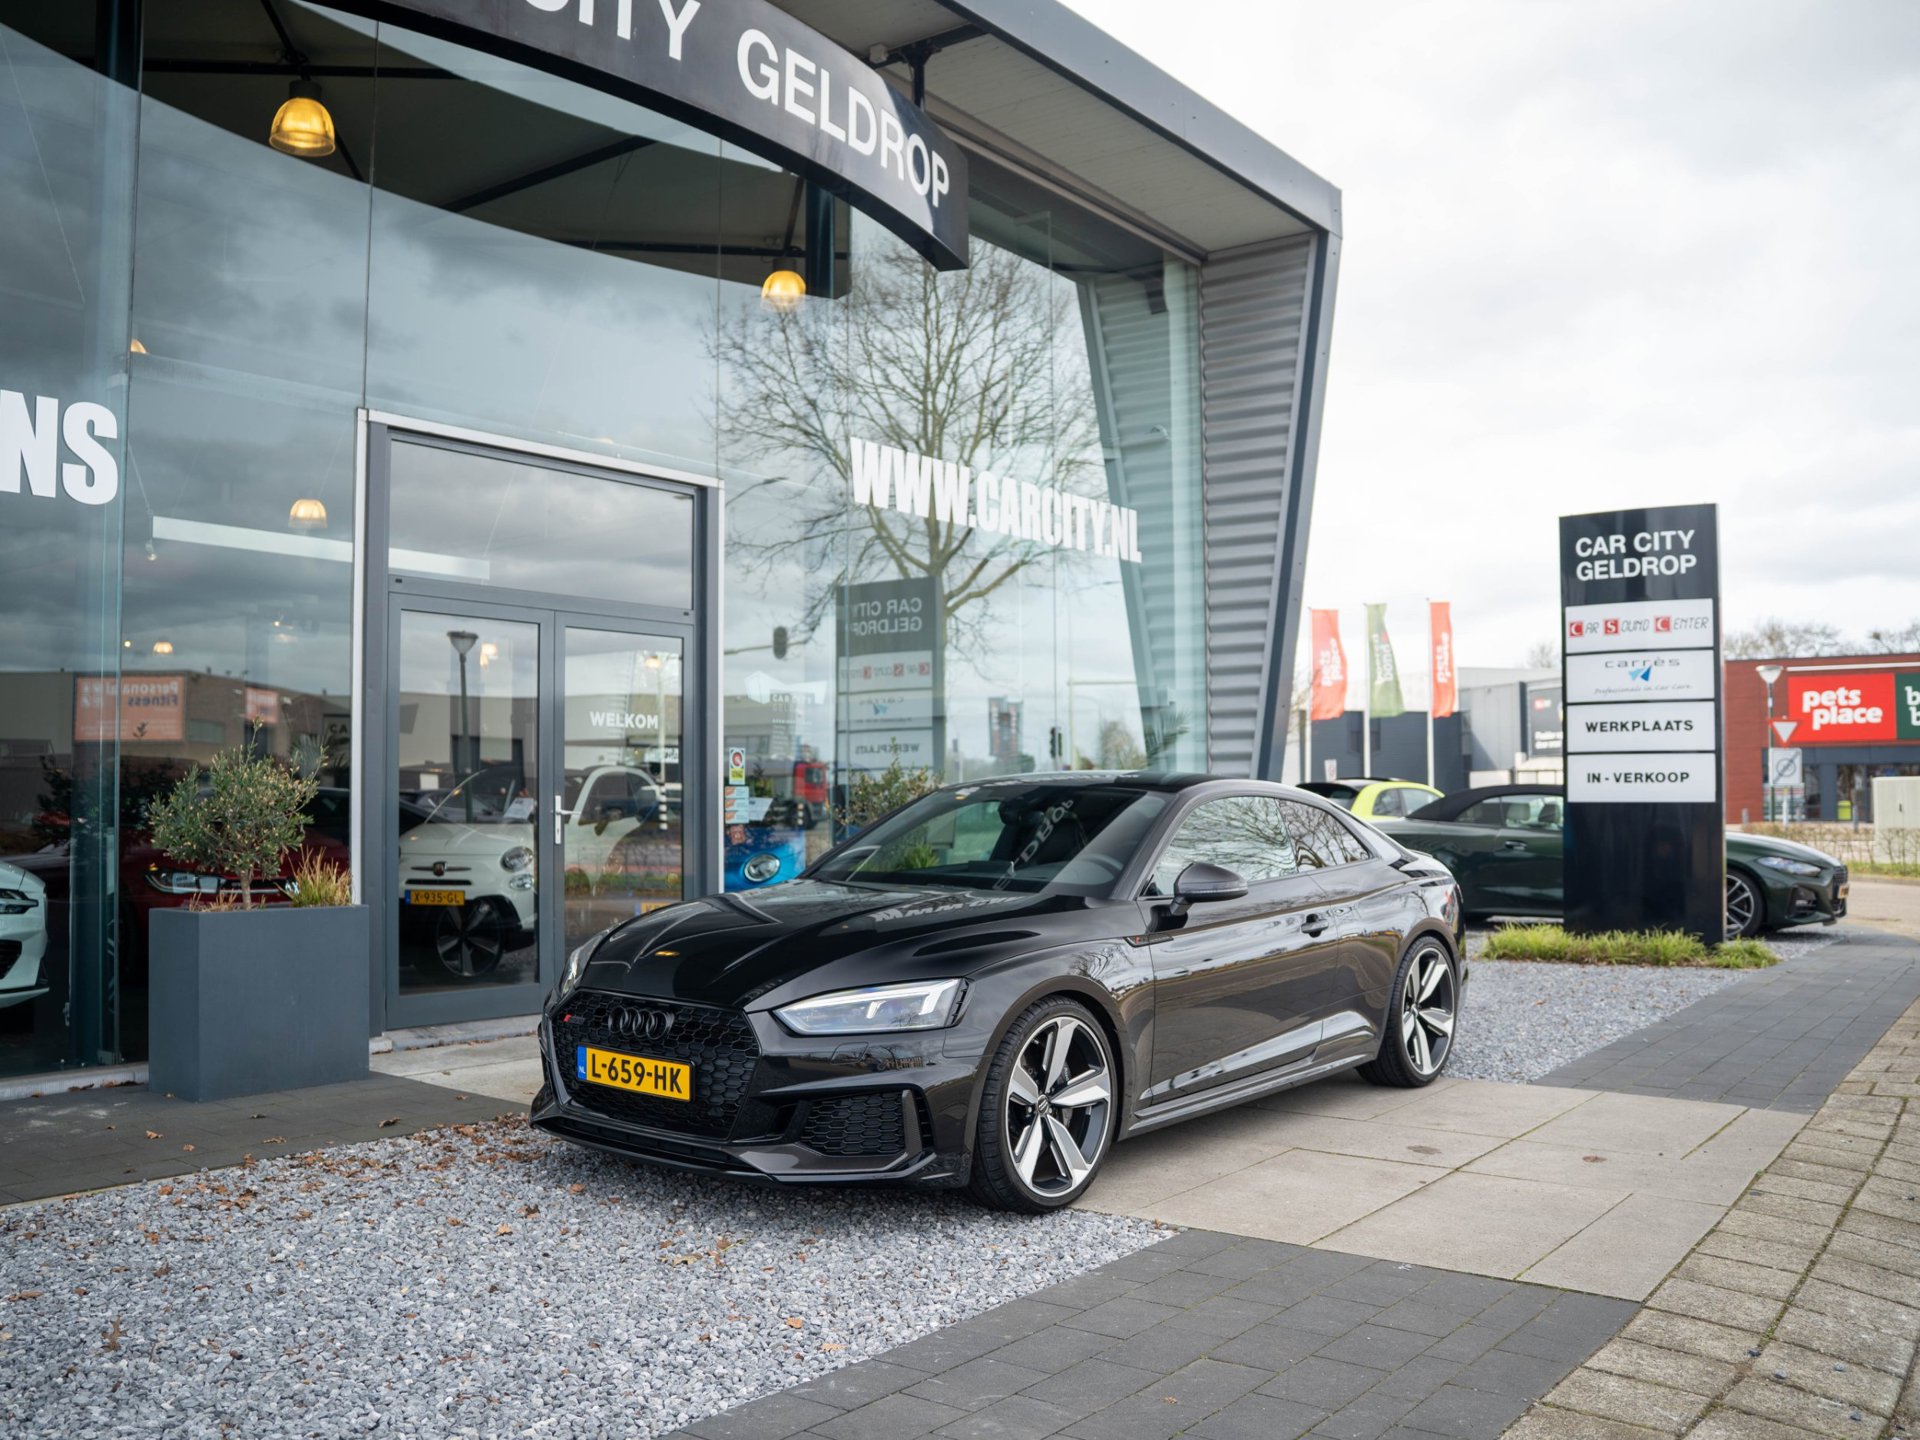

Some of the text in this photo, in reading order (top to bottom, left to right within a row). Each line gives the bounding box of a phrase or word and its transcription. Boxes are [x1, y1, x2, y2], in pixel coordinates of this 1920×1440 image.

[736, 28, 949, 207] GELDROP
[0, 389, 118, 505] NS
[850, 436, 1142, 563] WWW.CARCITY.NL
[1575, 529, 1695, 557] CAR CITY
[1575, 554, 1697, 581] GELDROP
[1654, 615, 1709, 633] CENTER
[1802, 686, 1861, 713] pets
[590, 711, 659, 729] WELKOM
[1585, 720, 1694, 733] WERKPLAATS
[1812, 706, 1883, 730] place
[413, 891, 460, 904] X-935-GL
[591, 1053, 683, 1094] L-659-HK
